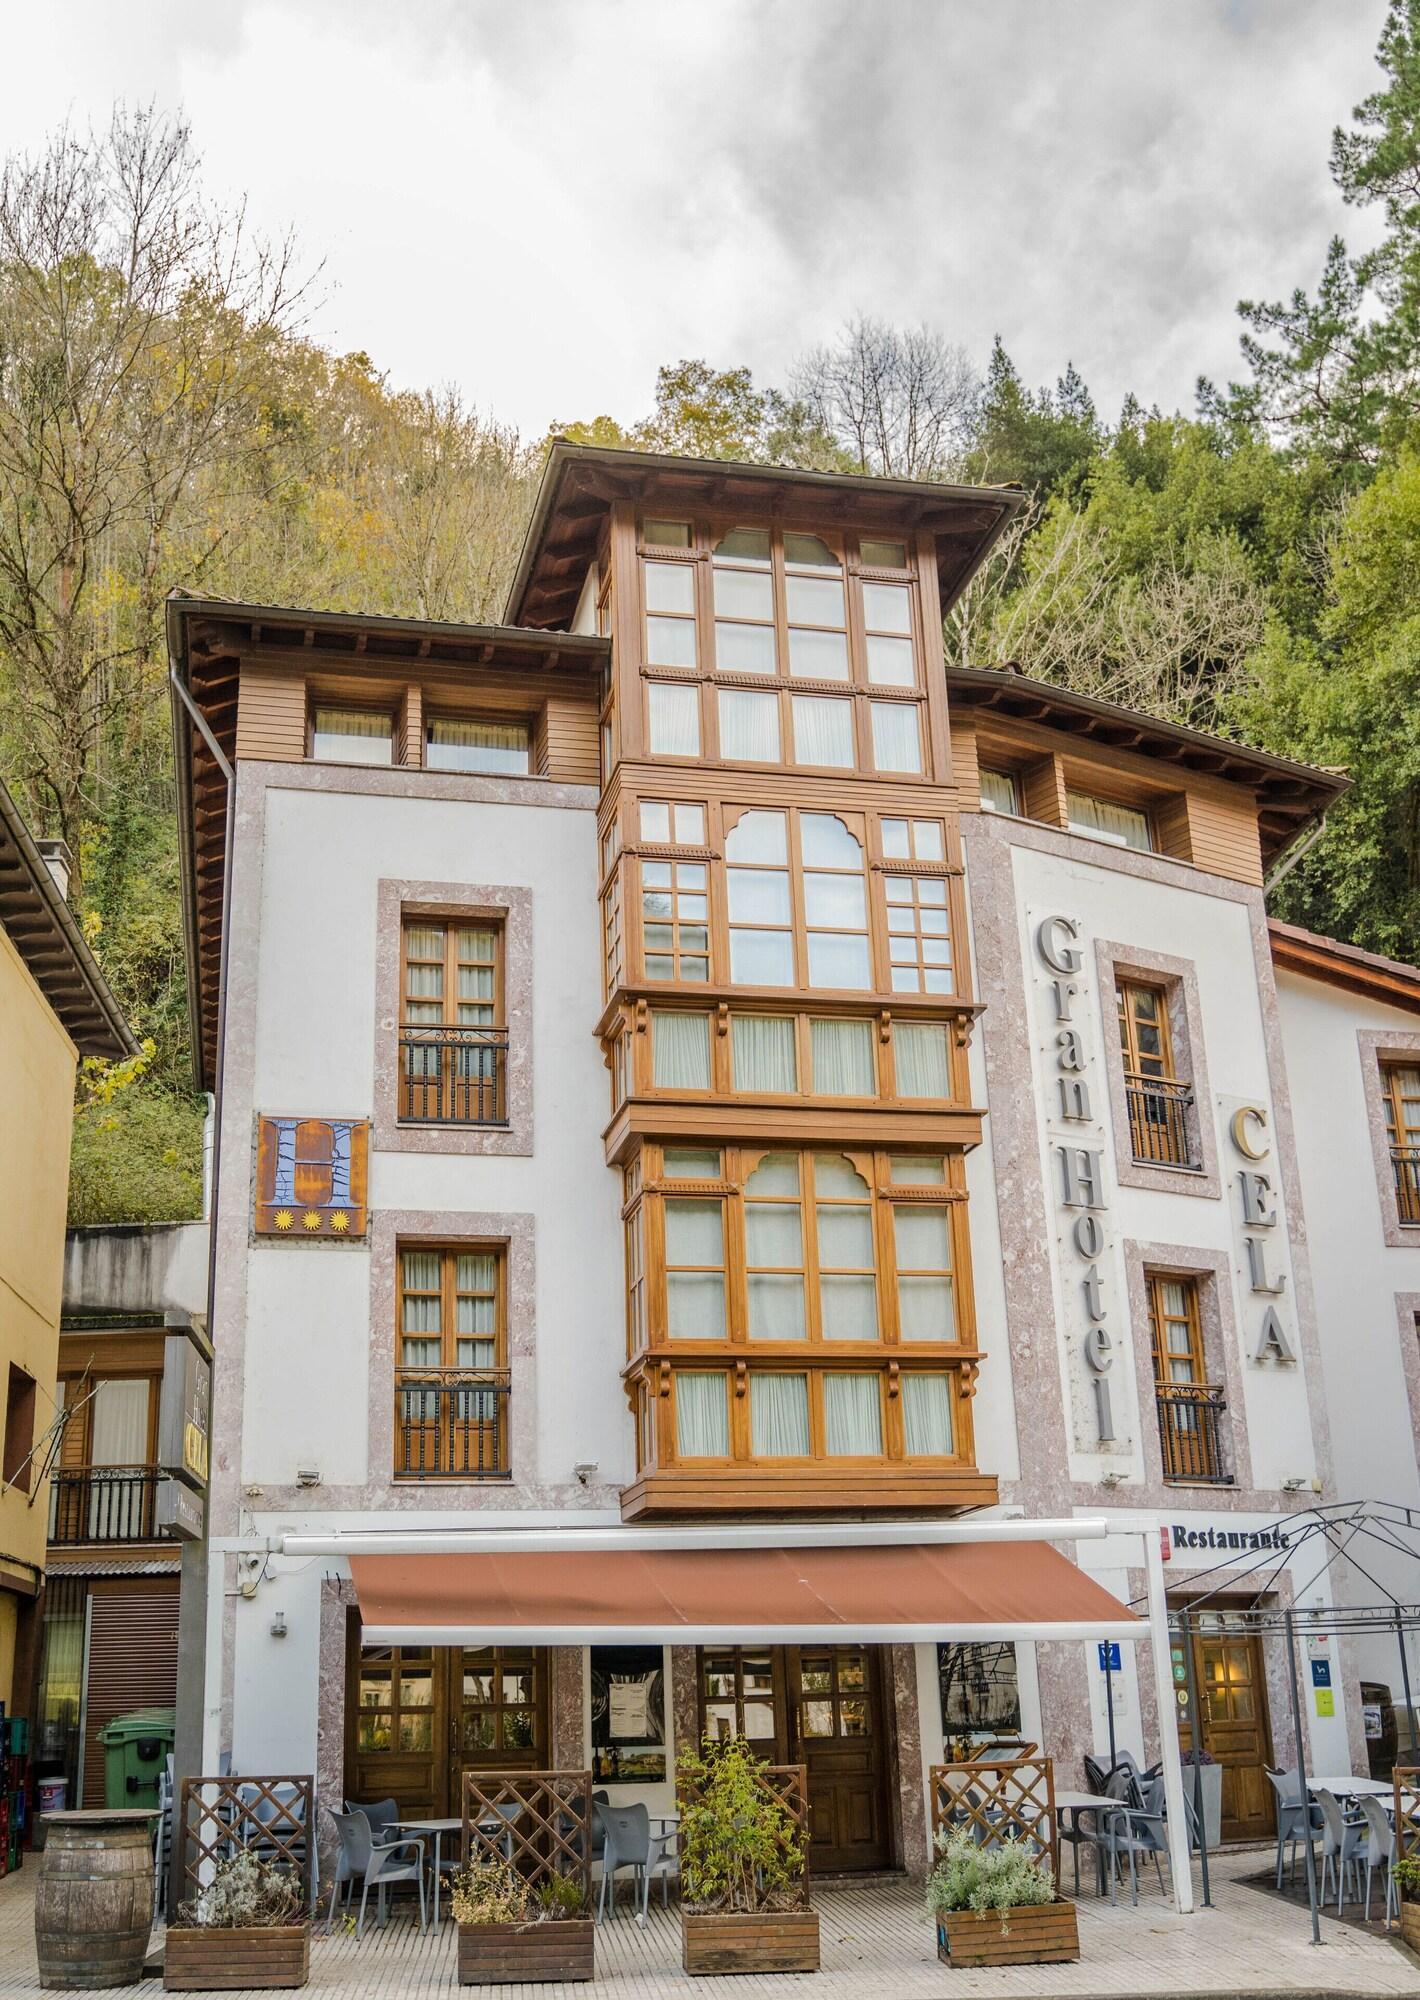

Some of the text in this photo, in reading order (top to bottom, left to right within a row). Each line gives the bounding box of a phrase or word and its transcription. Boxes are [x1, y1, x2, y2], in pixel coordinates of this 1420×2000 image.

[1038, 915, 1116, 1441] Gran Hotel
[1230, 1106, 1297, 1361] CELA
[1172, 1525, 1290, 1549] Restaurante
